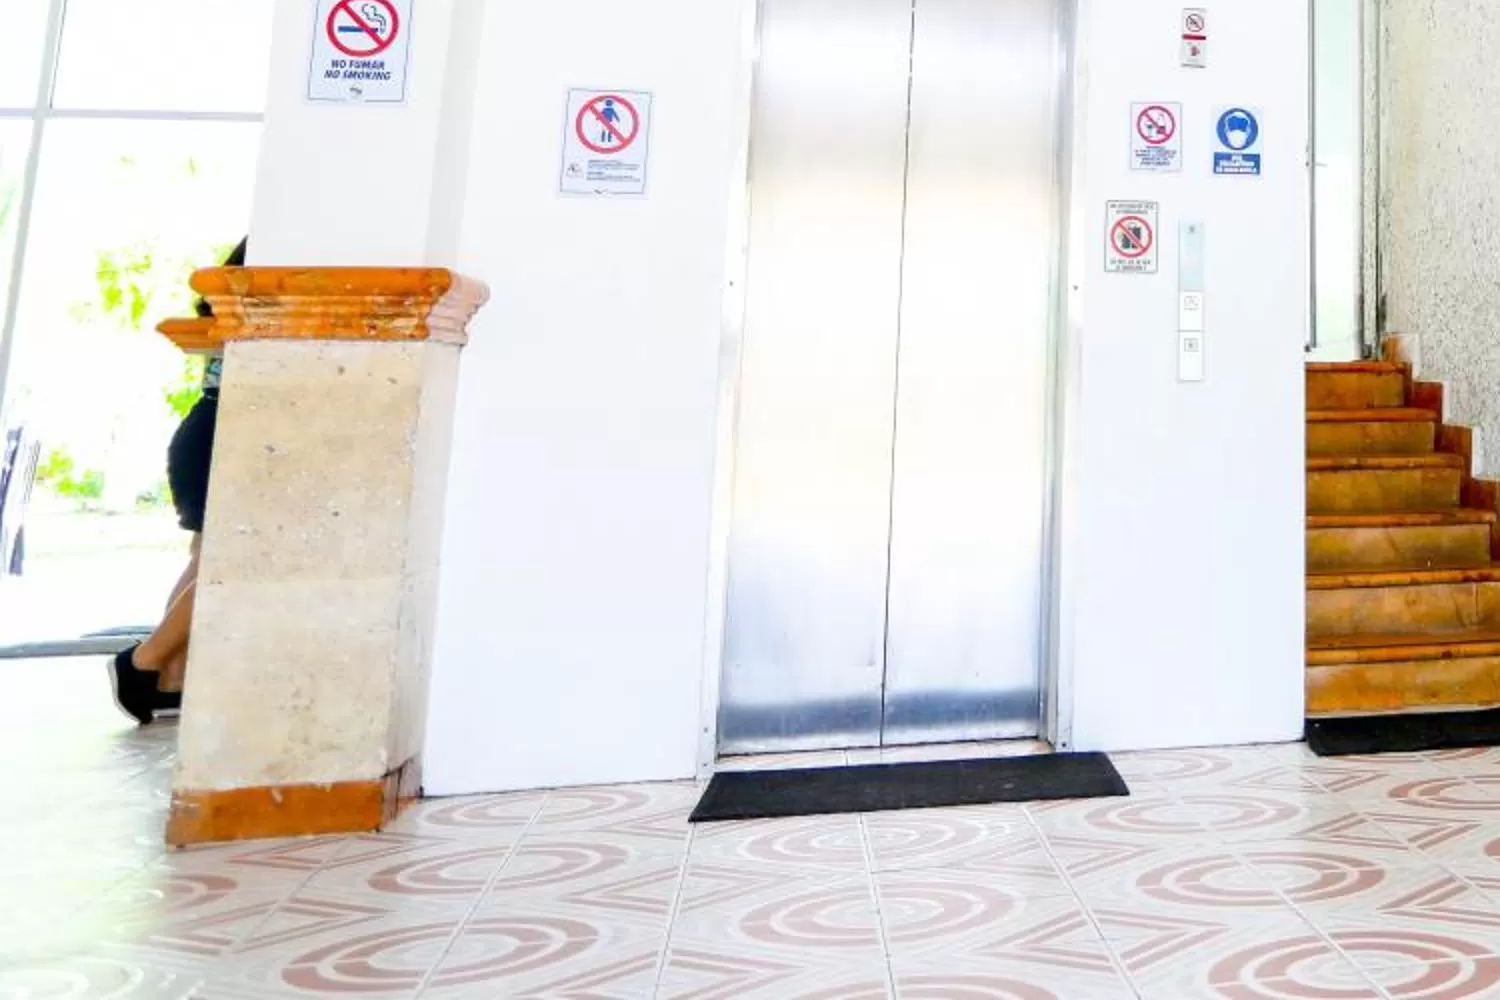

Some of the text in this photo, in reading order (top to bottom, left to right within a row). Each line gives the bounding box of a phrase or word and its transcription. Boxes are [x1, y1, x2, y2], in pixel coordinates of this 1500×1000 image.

[331, 60, 385, 70] NO FUMAR
[324, 70, 392, 81] NO SMOKING
